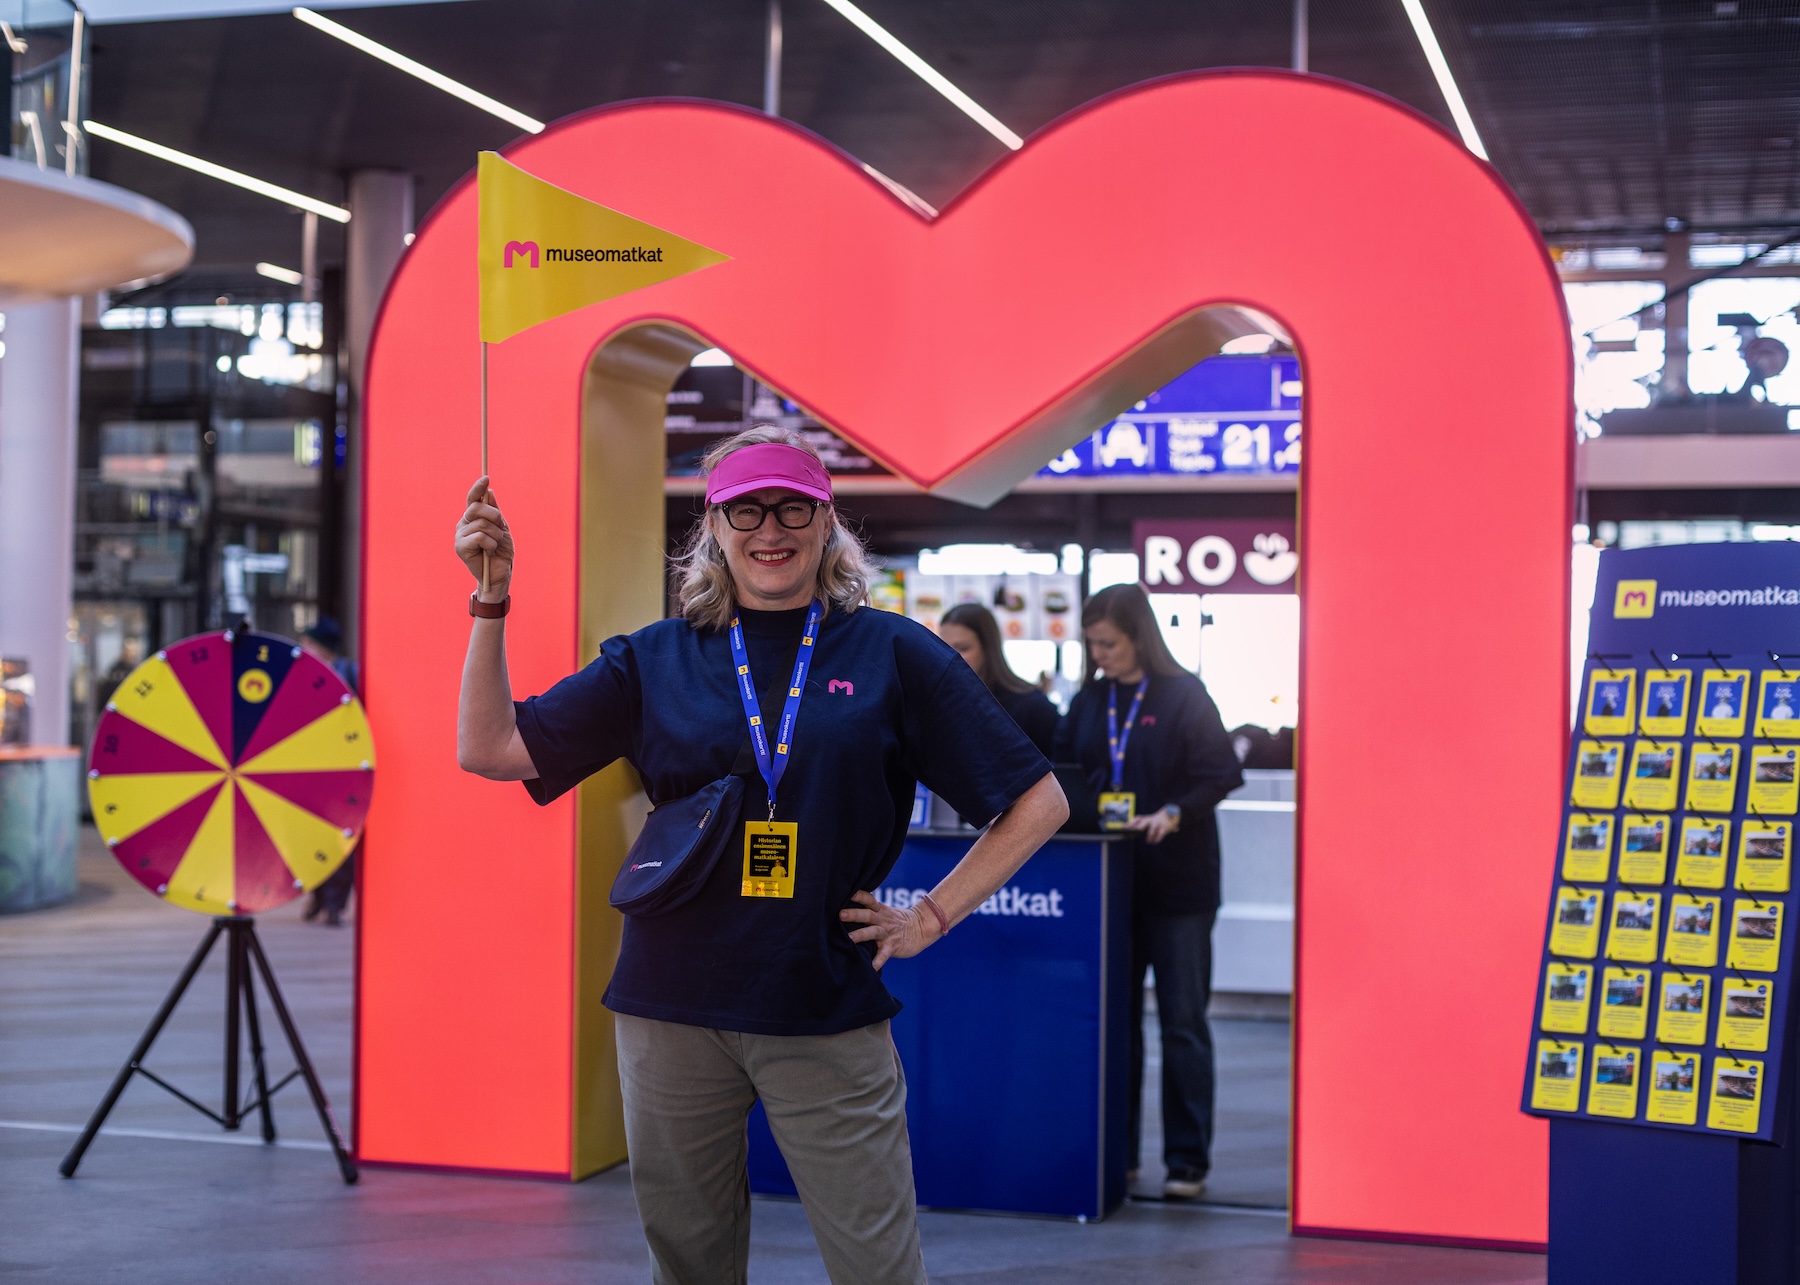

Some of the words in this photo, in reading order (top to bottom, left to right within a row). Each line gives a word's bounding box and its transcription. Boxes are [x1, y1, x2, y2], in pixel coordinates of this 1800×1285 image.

[546, 246, 664, 262] museomatkat
[1659, 585, 1800, 608] museomatka
[742, 674, 753, 700] museokortti
[793, 661, 804, 688] museokortti
[754, 725, 766, 756] museokortti
[781, 713, 791, 744] museokortti
